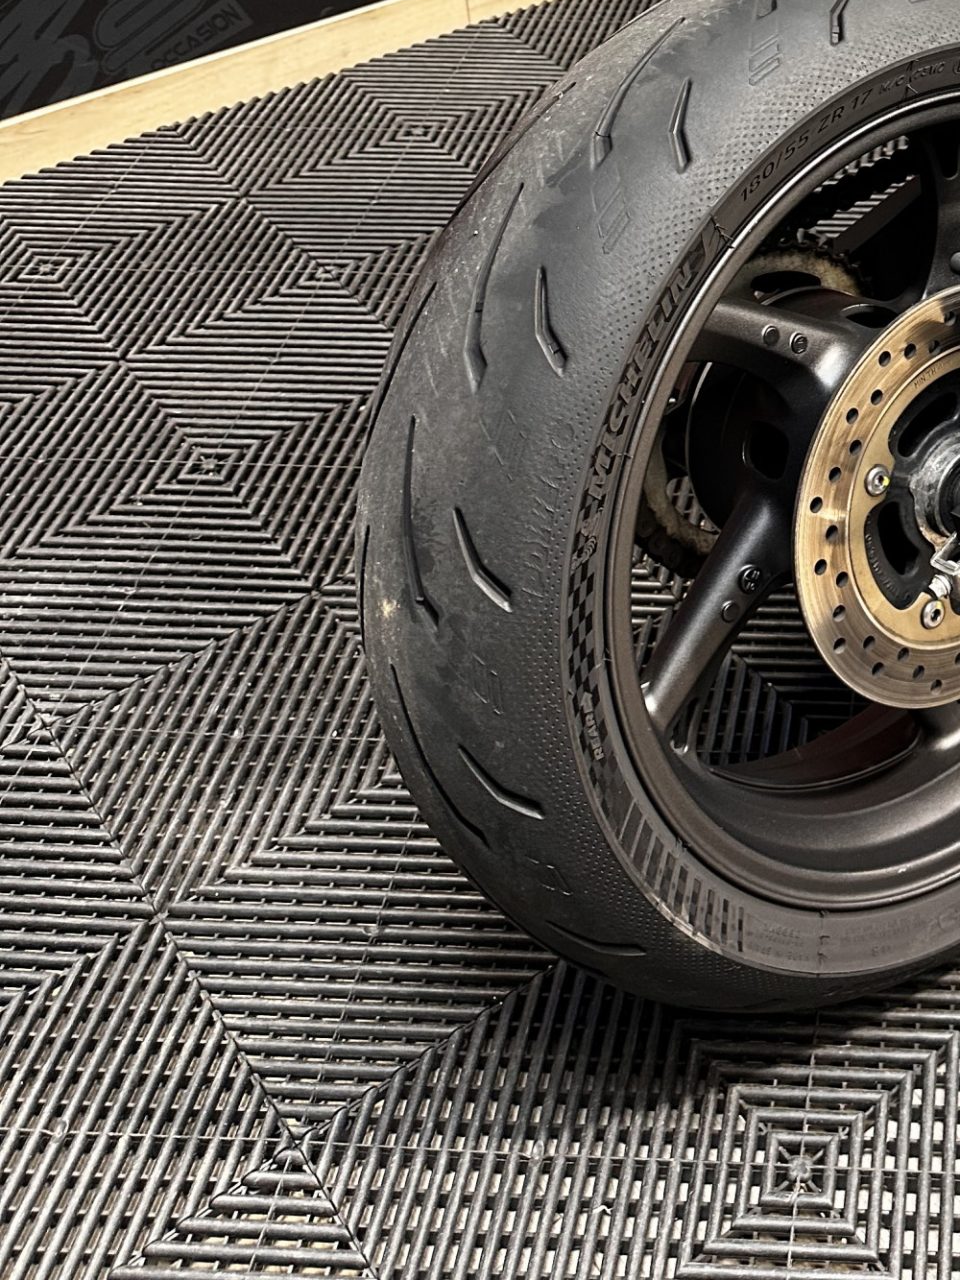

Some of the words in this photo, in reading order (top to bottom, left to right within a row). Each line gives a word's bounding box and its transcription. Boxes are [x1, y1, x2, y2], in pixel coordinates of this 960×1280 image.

[740, 128, 812, 203] 180/55
[817, 104, 846, 134] ZR
[850, 87, 875, 112] 17
[586, 264, 698, 503] MICHELIN
[584, 712, 606, 762] REAR
